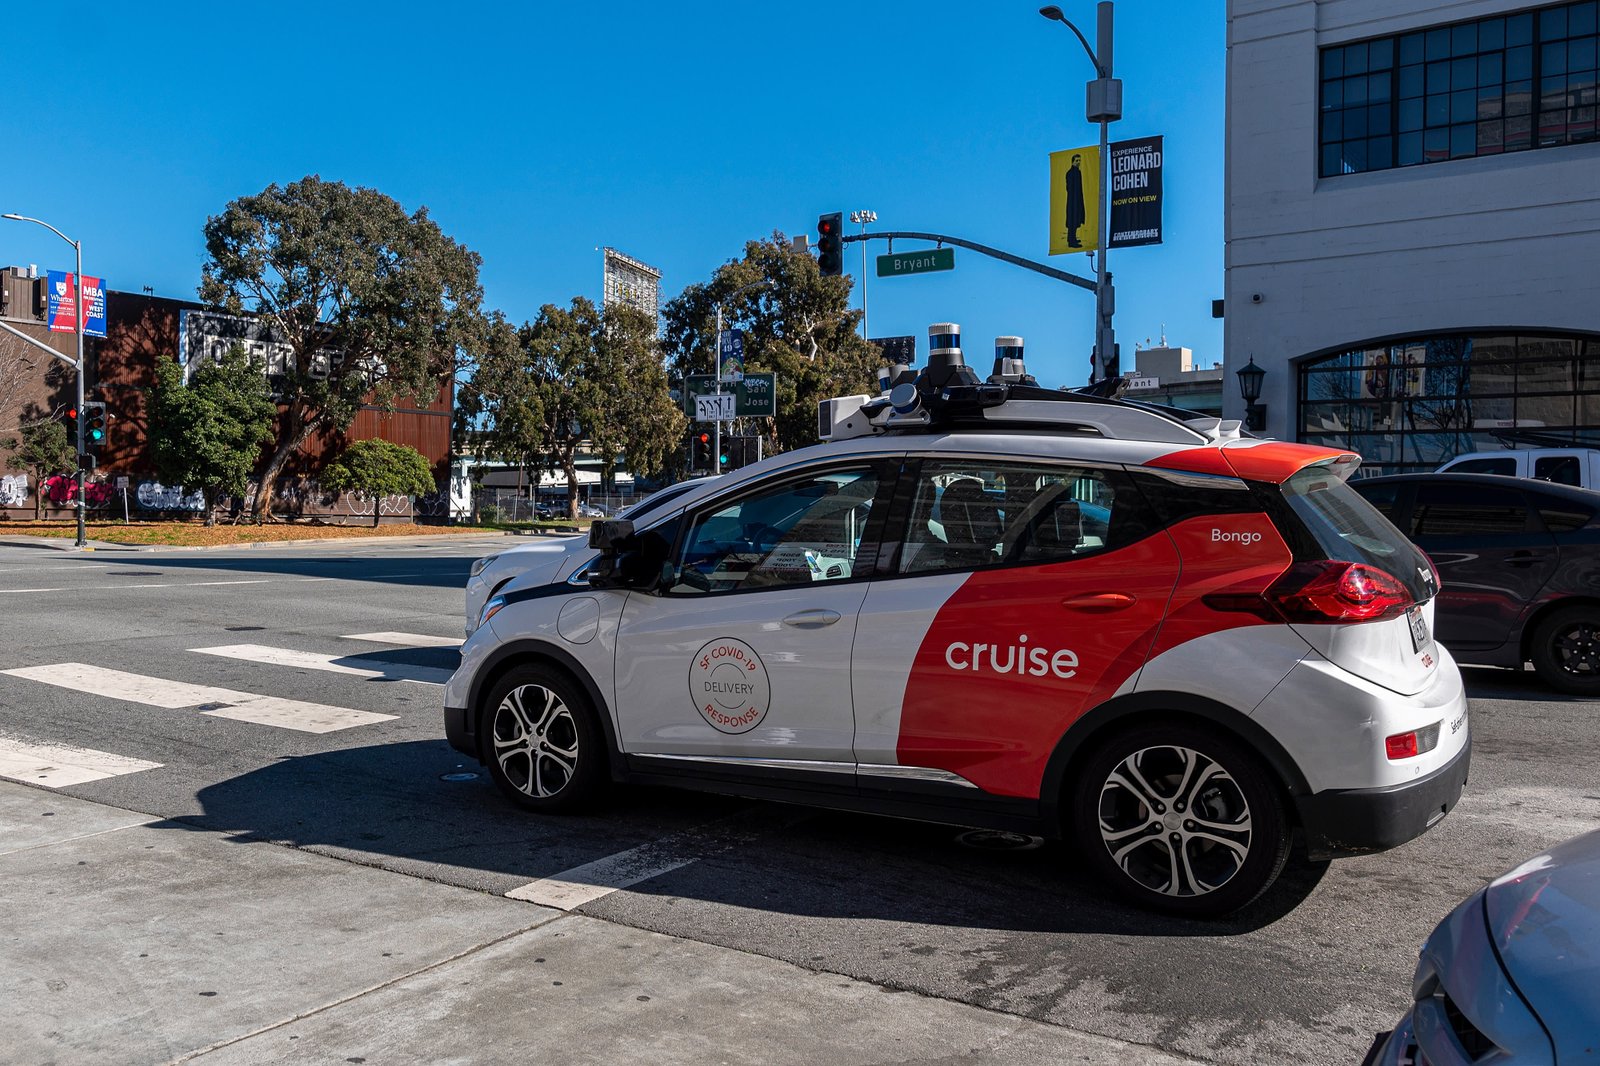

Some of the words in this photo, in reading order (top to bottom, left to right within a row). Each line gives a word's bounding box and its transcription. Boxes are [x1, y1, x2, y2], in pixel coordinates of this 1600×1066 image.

[1112, 145, 1153, 157] EXPERIENCE
[1113, 152, 1161, 173] LEONARD
[1113, 172, 1148, 191] COHEN
[1112, 198, 1128, 206] NOW
[1139, 195, 1157, 203] VIEW
[894, 255, 936, 271] Bryant
[83, 286, 103, 298] MBA
[86, 311, 103, 319] COAST
[88, 304, 103, 313] WEST
[747, 385, 767, 394] San
[745, 398, 769, 406] Jose
[1211, 528, 1262, 546] Bongo
[700, 654, 711, 671] SF
[711, 646, 756, 671] COVID-19
[945, 634, 1079, 679] cruise
[704, 681, 755, 694] DELIVERY
[704, 704, 759, 727] RESPONSE
